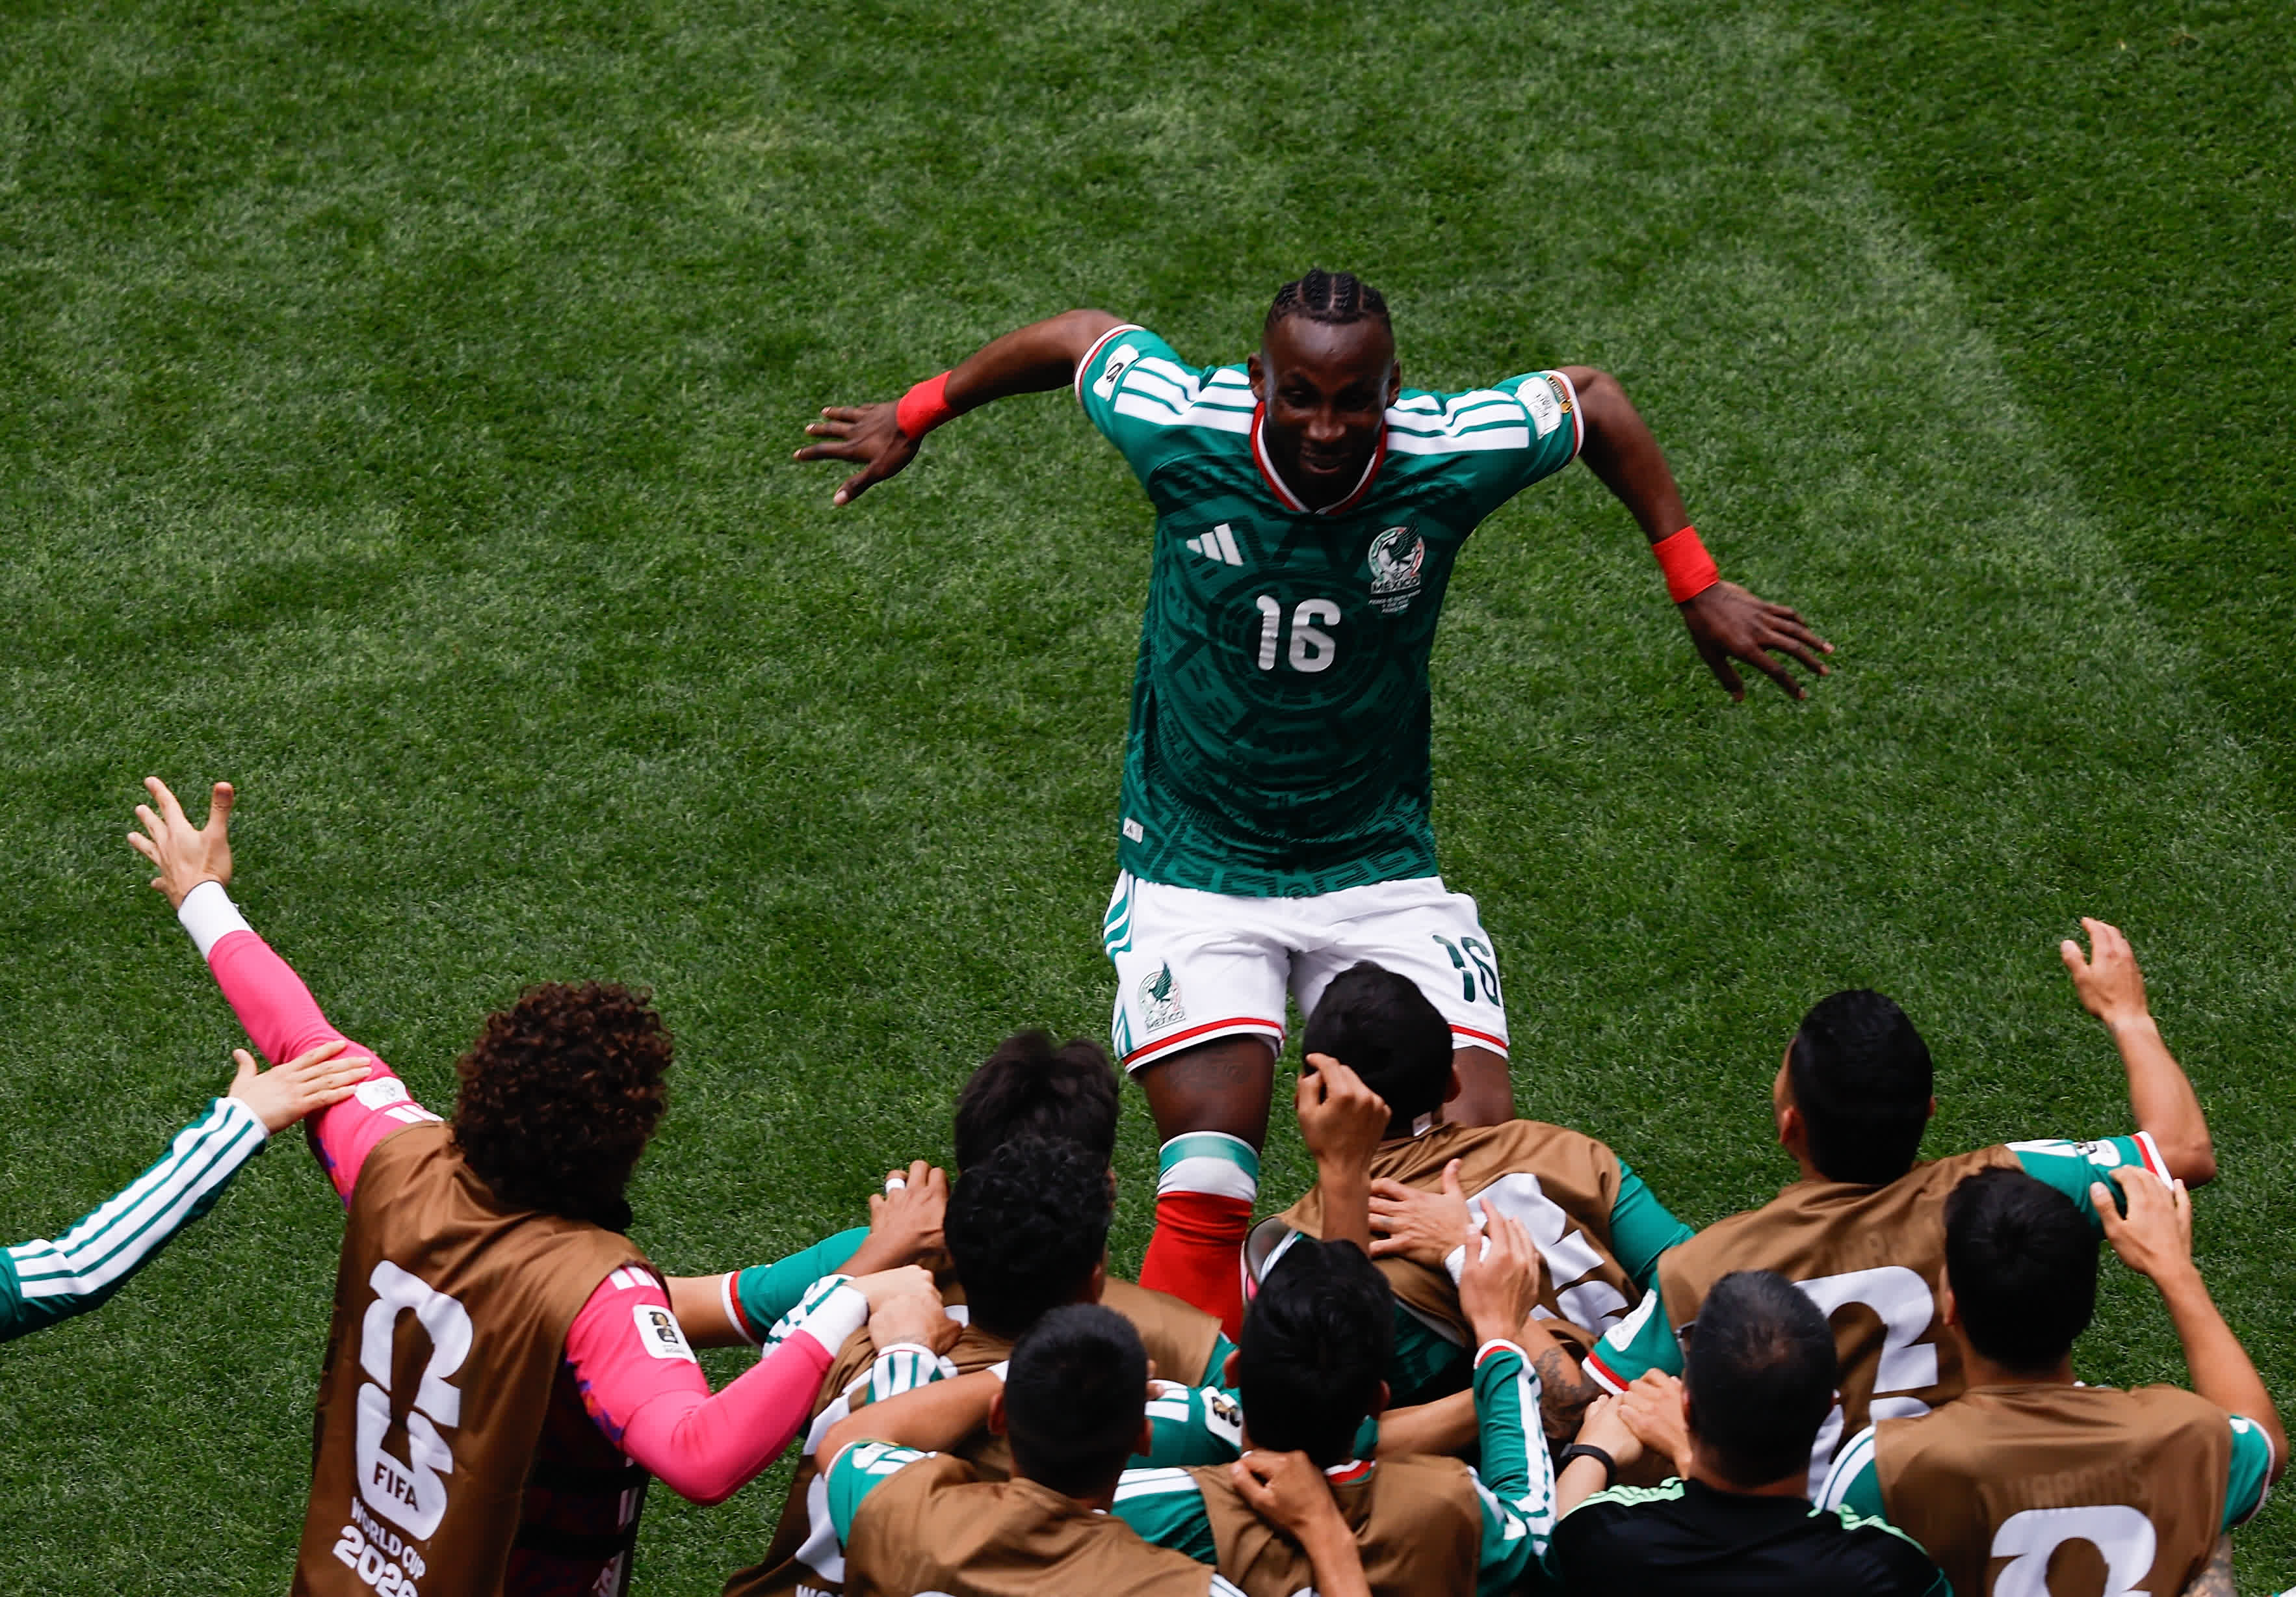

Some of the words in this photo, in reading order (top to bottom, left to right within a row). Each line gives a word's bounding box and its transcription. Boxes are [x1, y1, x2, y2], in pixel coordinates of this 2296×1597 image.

[1256, 594, 1341, 672] 16
[1432, 935, 1500, 1007] 16
[373, 1461, 420, 1512] FIFA
[350, 1496, 402, 1557] WORLD
[402, 1545, 426, 1581] CUP
